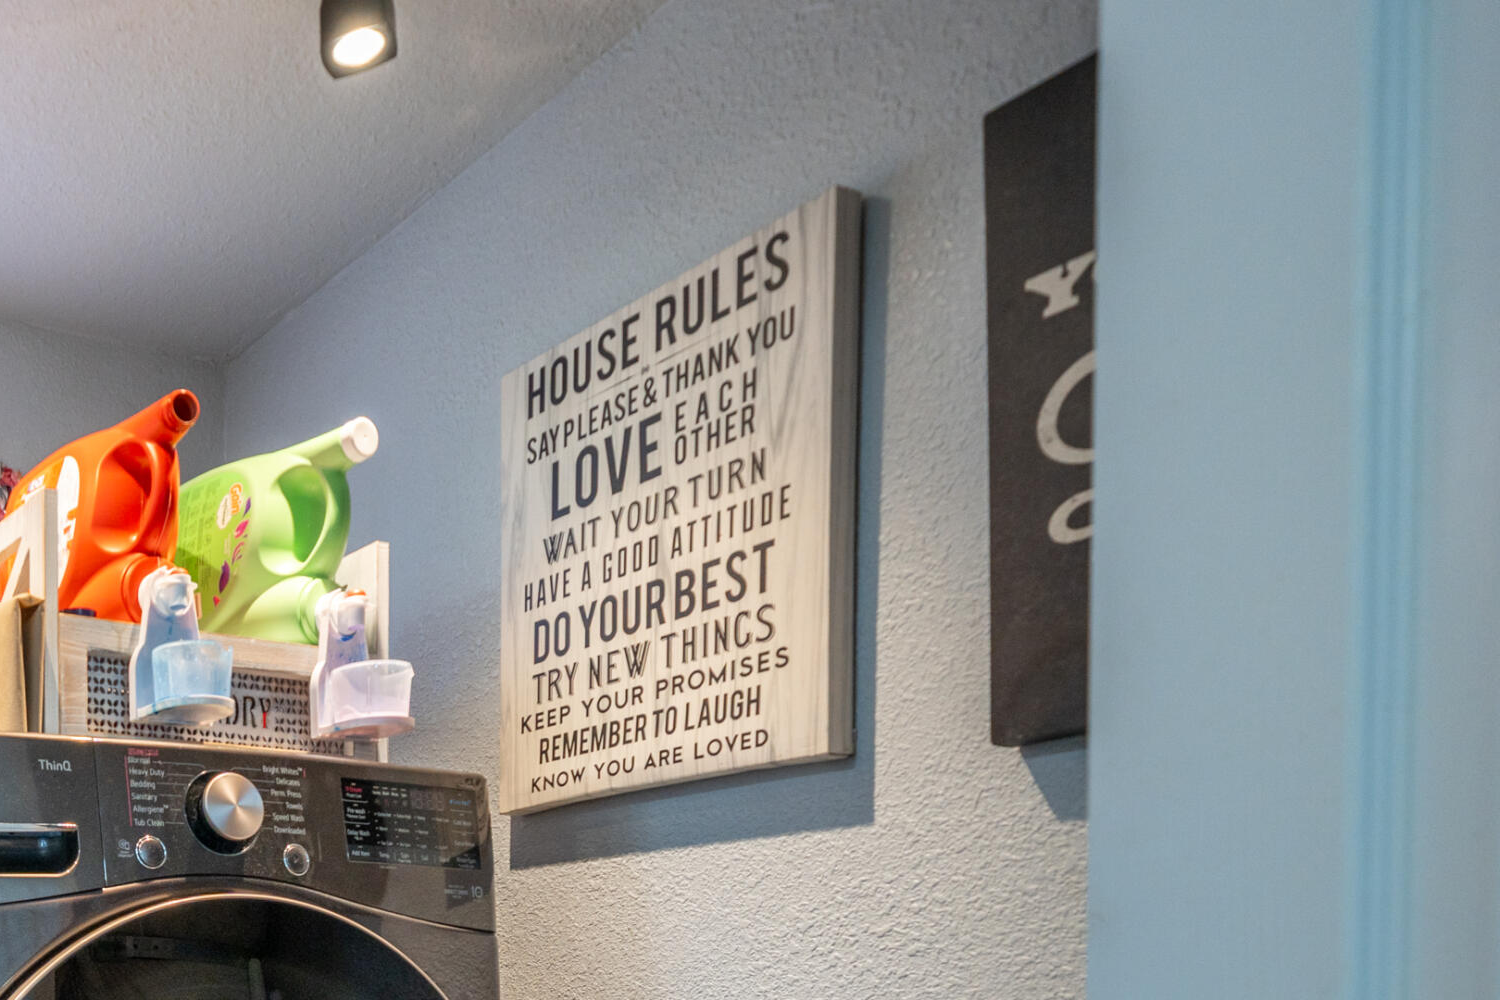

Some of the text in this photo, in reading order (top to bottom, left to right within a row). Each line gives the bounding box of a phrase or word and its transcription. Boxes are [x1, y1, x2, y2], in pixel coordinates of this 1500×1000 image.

[527, 231, 789, 420] HOUSE RULES
[527, 305, 796, 464] SAY PLEASE & THANK YOU
[675, 367, 757, 434] EACH
[551, 411, 662, 521] LOVE
[674, 403, 755, 465] OTHER
[542, 447, 766, 565] WAIT YOUR TURN
[524, 484, 791, 613] HAVE A GOOD ATTITUDE
[534, 538, 776, 665] DO YOUR BEST
[532, 603, 776, 705] TRY NEW THINGS
[521, 646, 790, 735] KEEP YOUR PROMISES
[539, 685, 762, 765] REMEMBER TO LAUGH
[37, 759, 72, 772] ThinQ
[129, 767, 165, 778] Heavy Duty
[130, 779, 156, 790] Bedding
[275, 777, 300, 787] Delicates
[531, 729, 769, 794] KNOW YOU ARE LOVED
[131, 792, 158, 802] Sanitary
[134, 818, 165, 827] Tub Clean
[471, 886, 483, 898] 10
